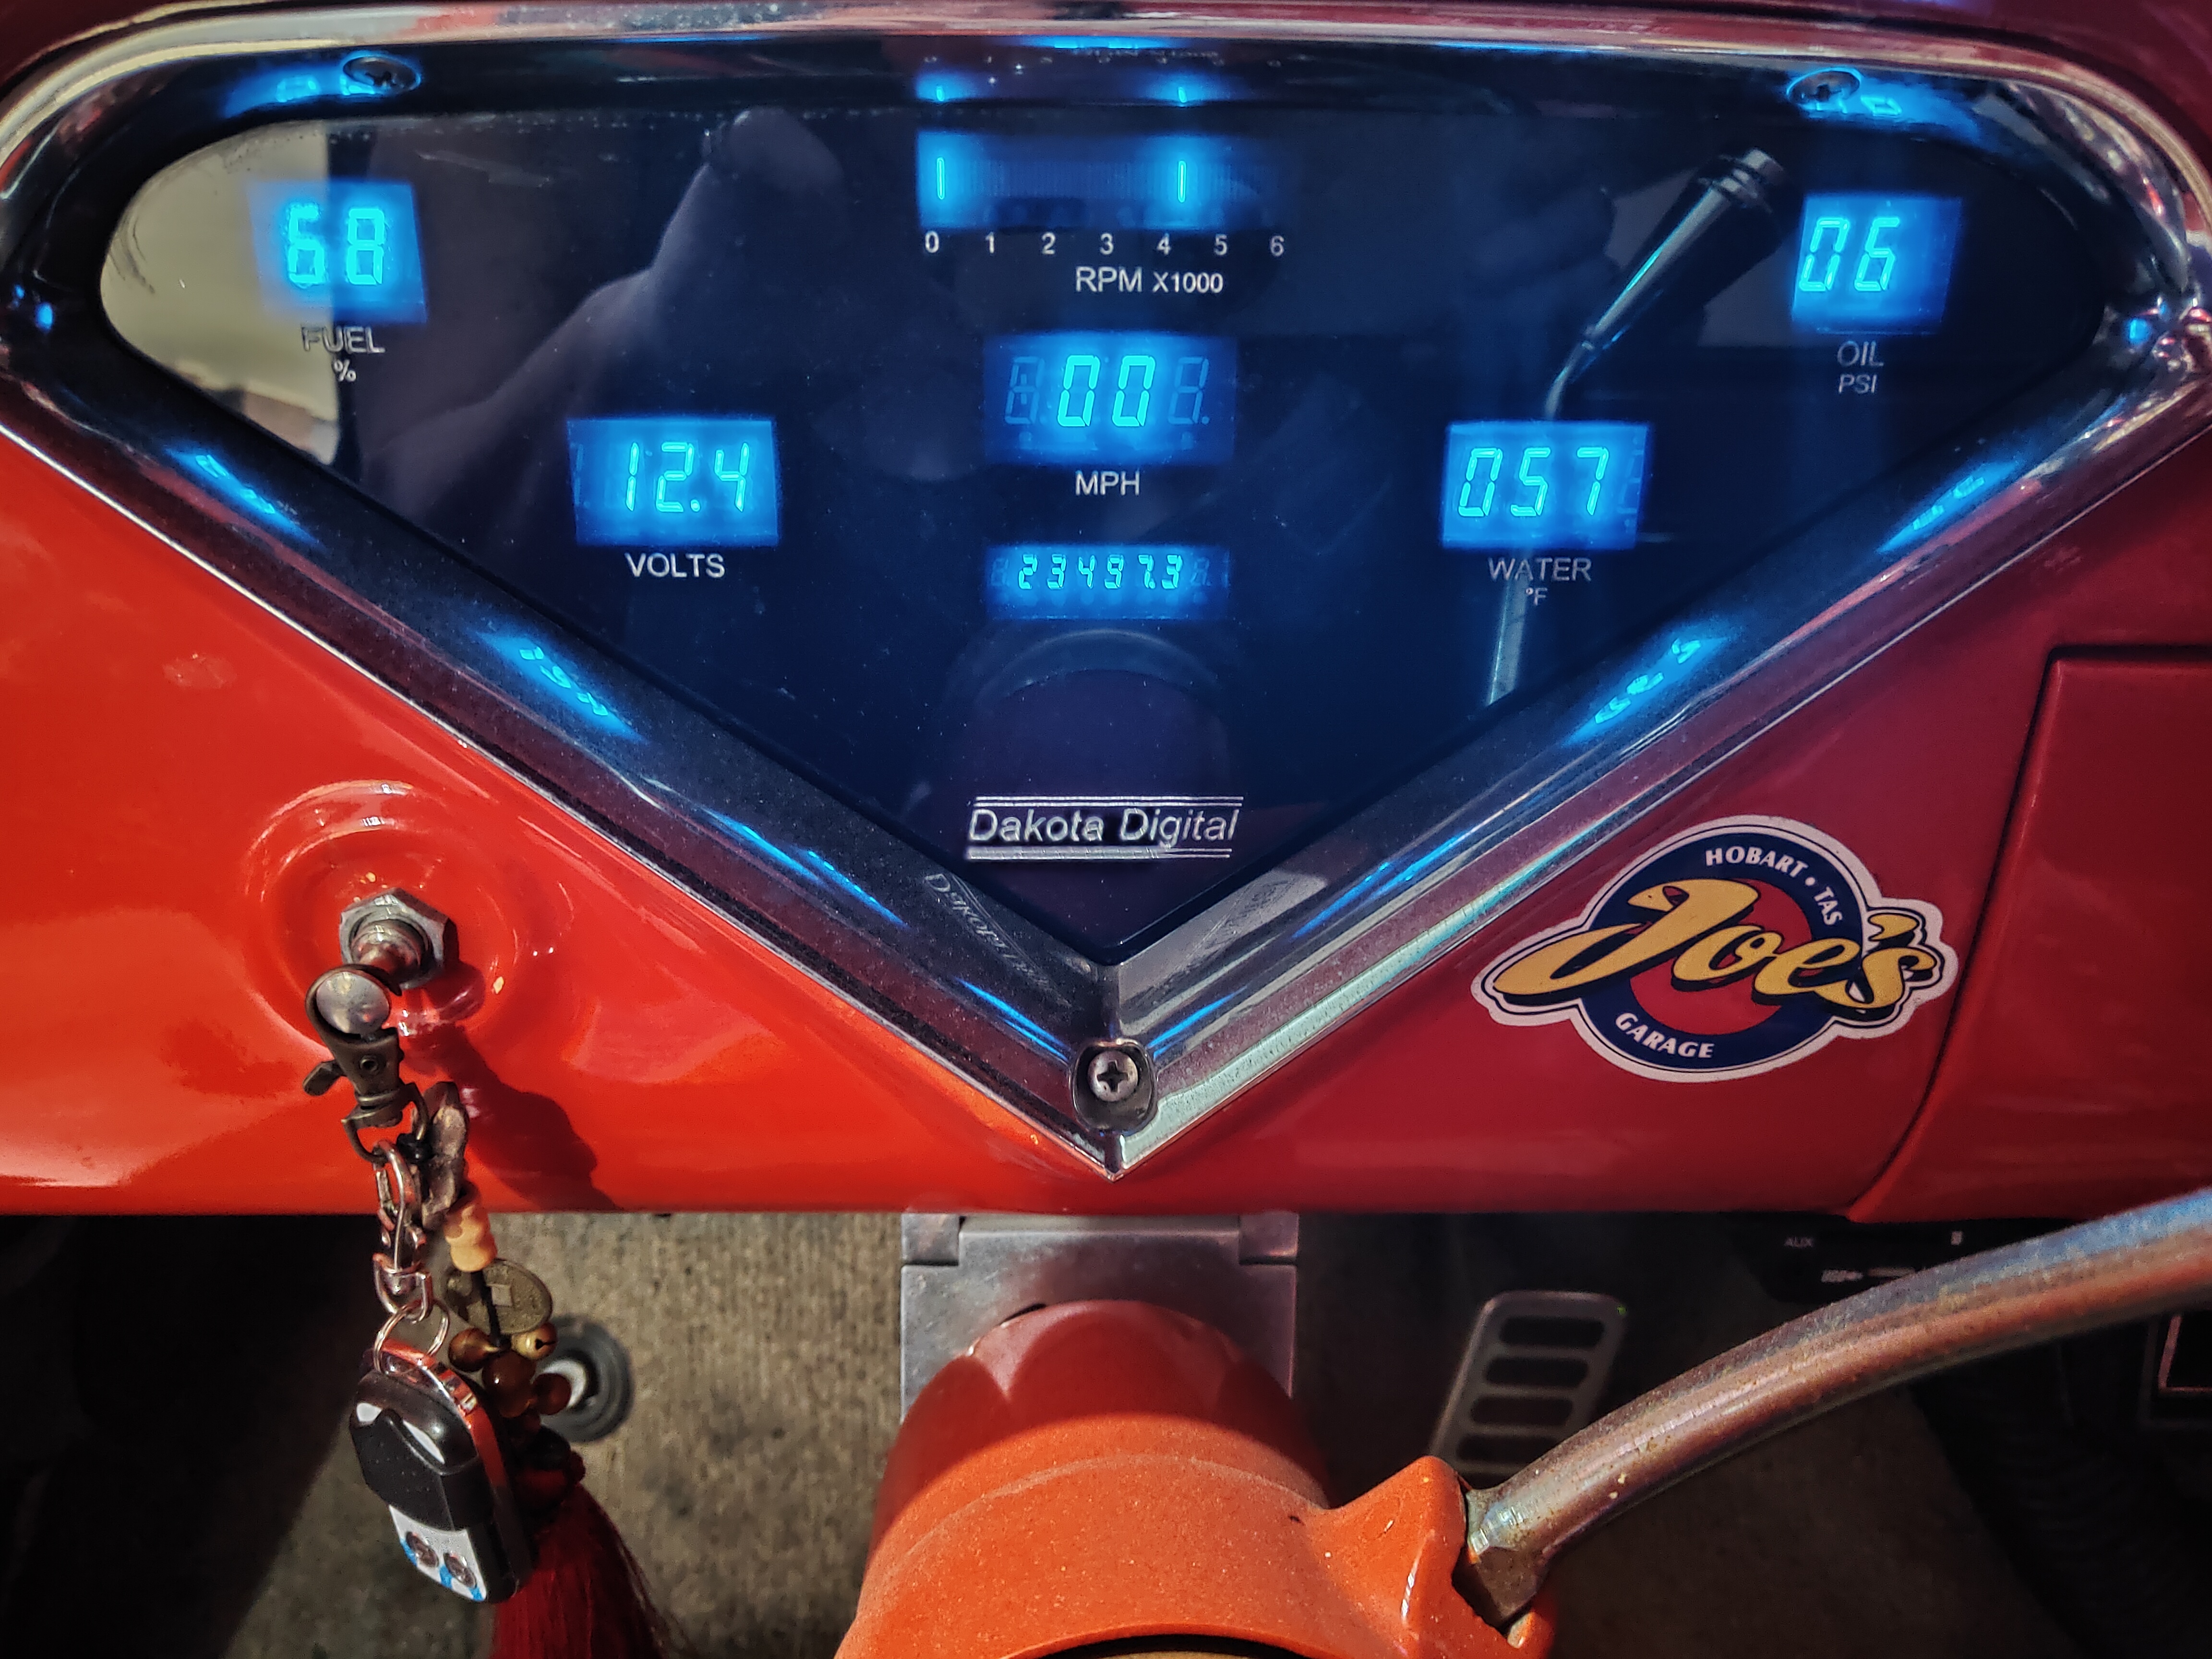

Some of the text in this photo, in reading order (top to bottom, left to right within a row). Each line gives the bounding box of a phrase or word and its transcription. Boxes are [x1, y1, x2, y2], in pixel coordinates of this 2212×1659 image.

[287, 203, 385, 288] 68
[924, 231, 1284, 257] 0 1 2 3 4 5 6
[1799, 216, 1900, 292] 06
[1075, 266, 1224, 293] RPM X1000
[301, 326, 385, 354] FUEL
[1837, 340, 1884, 368] OIL
[333, 360, 356, 382] %
[1838, 373, 1877, 394] PSI
[625, 442, 750, 513] 12.4
[1075, 471, 1140, 496] MPH
[1458, 447, 1609, 517] 057
[624, 553, 726, 578] VOLTS
[1487, 557, 1593, 582] WATER
[968, 808, 1240, 849] Dakota Digital
[1705, 845, 1844, 927] HOBART TAS
[1493, 878, 1937, 1010] Joe's
[1615, 1010, 1715, 1059] GARAGE
